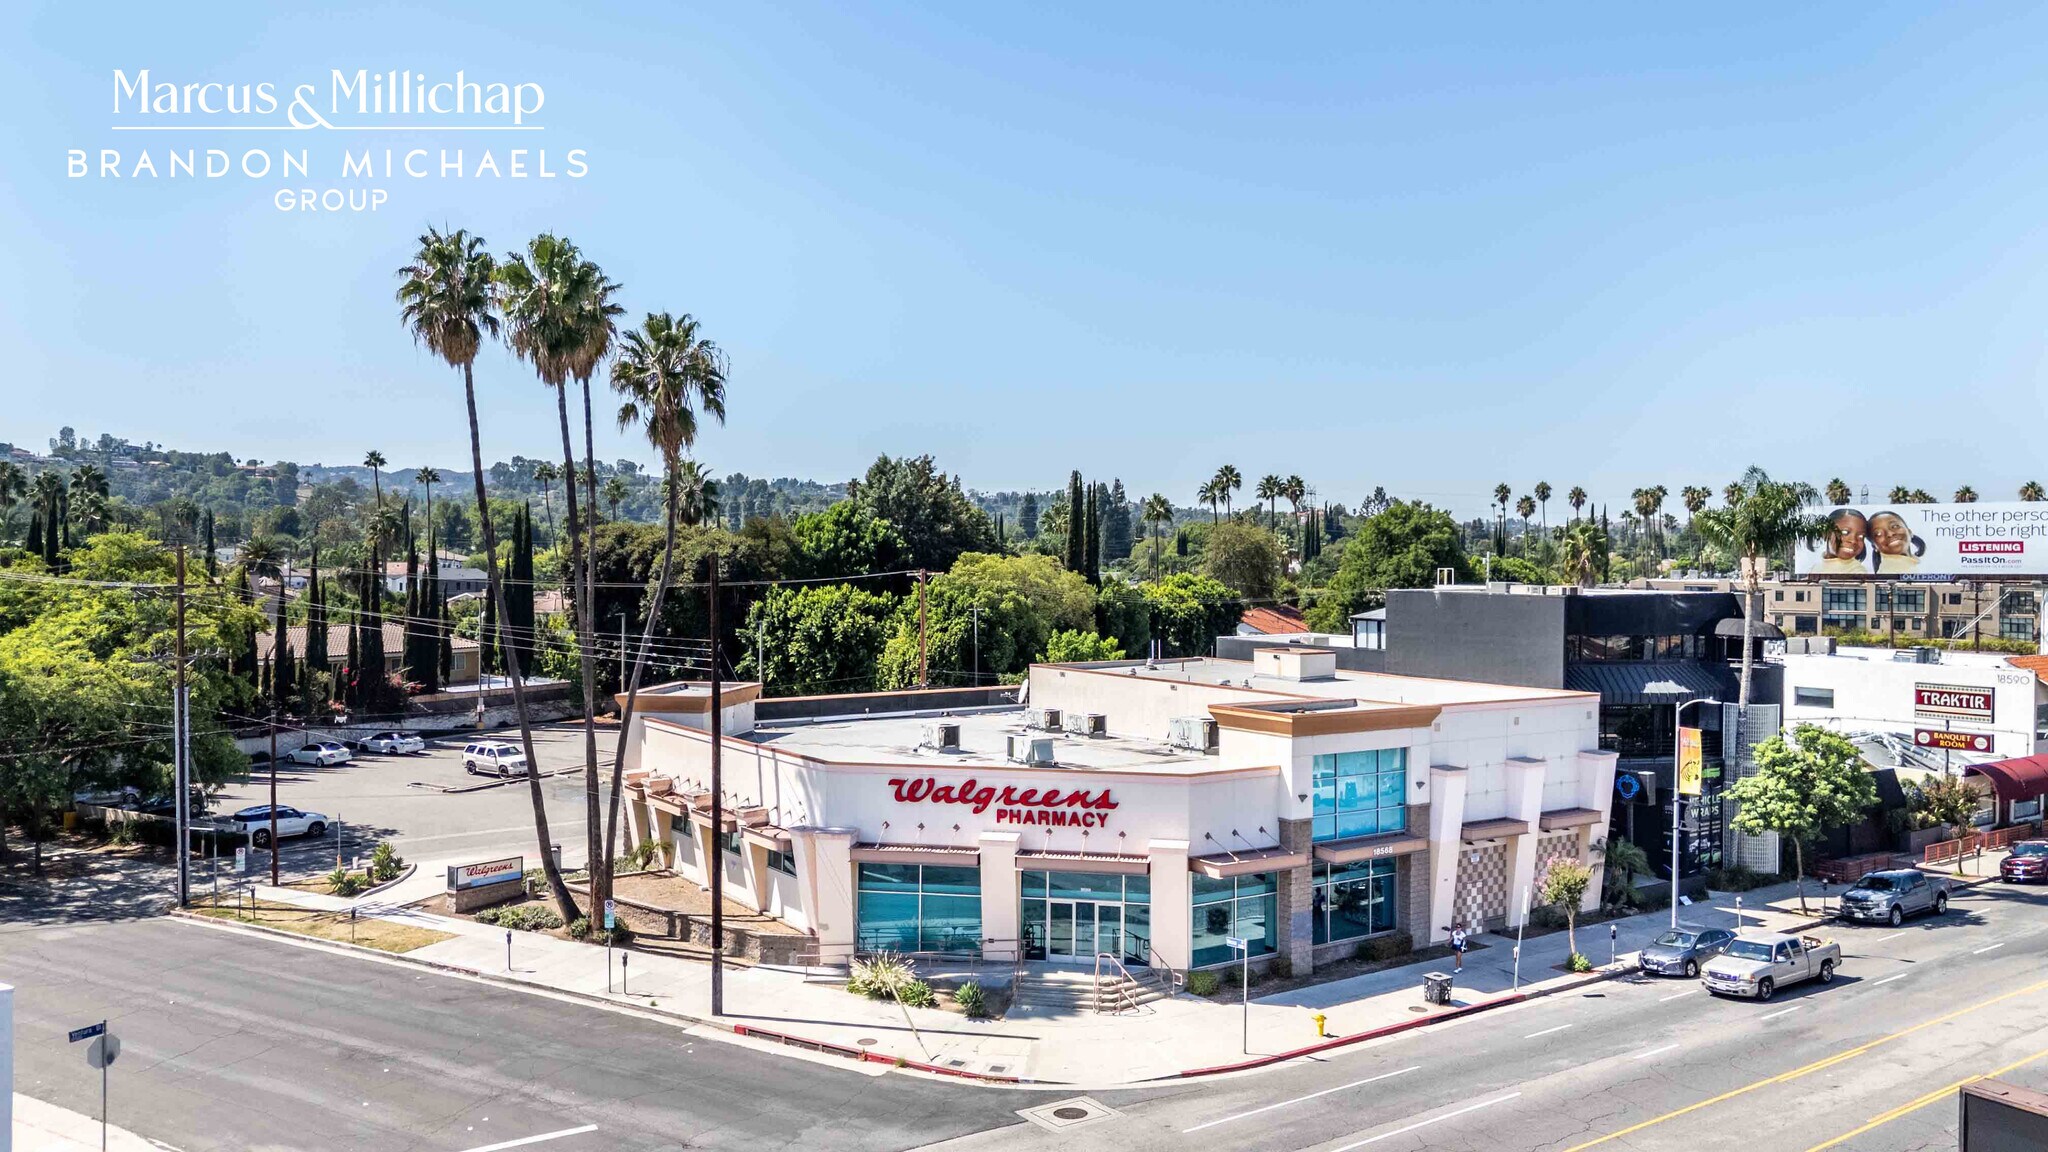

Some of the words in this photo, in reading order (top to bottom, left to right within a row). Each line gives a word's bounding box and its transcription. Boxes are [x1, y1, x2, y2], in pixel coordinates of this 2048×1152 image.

[1920, 510, 1951, 522] The
[1955, 509, 1999, 522] other
[1936, 523, 1982, 539] might
[1986, 524, 2007, 537] be
[2010, 523, 2047, 539] right
[1961, 544, 2021, 552] LISTENING
[1997, 674, 2030, 685] 18590
[1921, 691, 1985, 709] TRAKTIR
[1933, 732, 1971, 742] BANQUET
[1939, 740, 1966, 749] ROOM
[888, 777, 1119, 815] Walgreens
[996, 808, 1109, 828] PHARMACY
[1373, 846, 1392, 855] 18568
[465, 862, 513, 877] Walgreens
